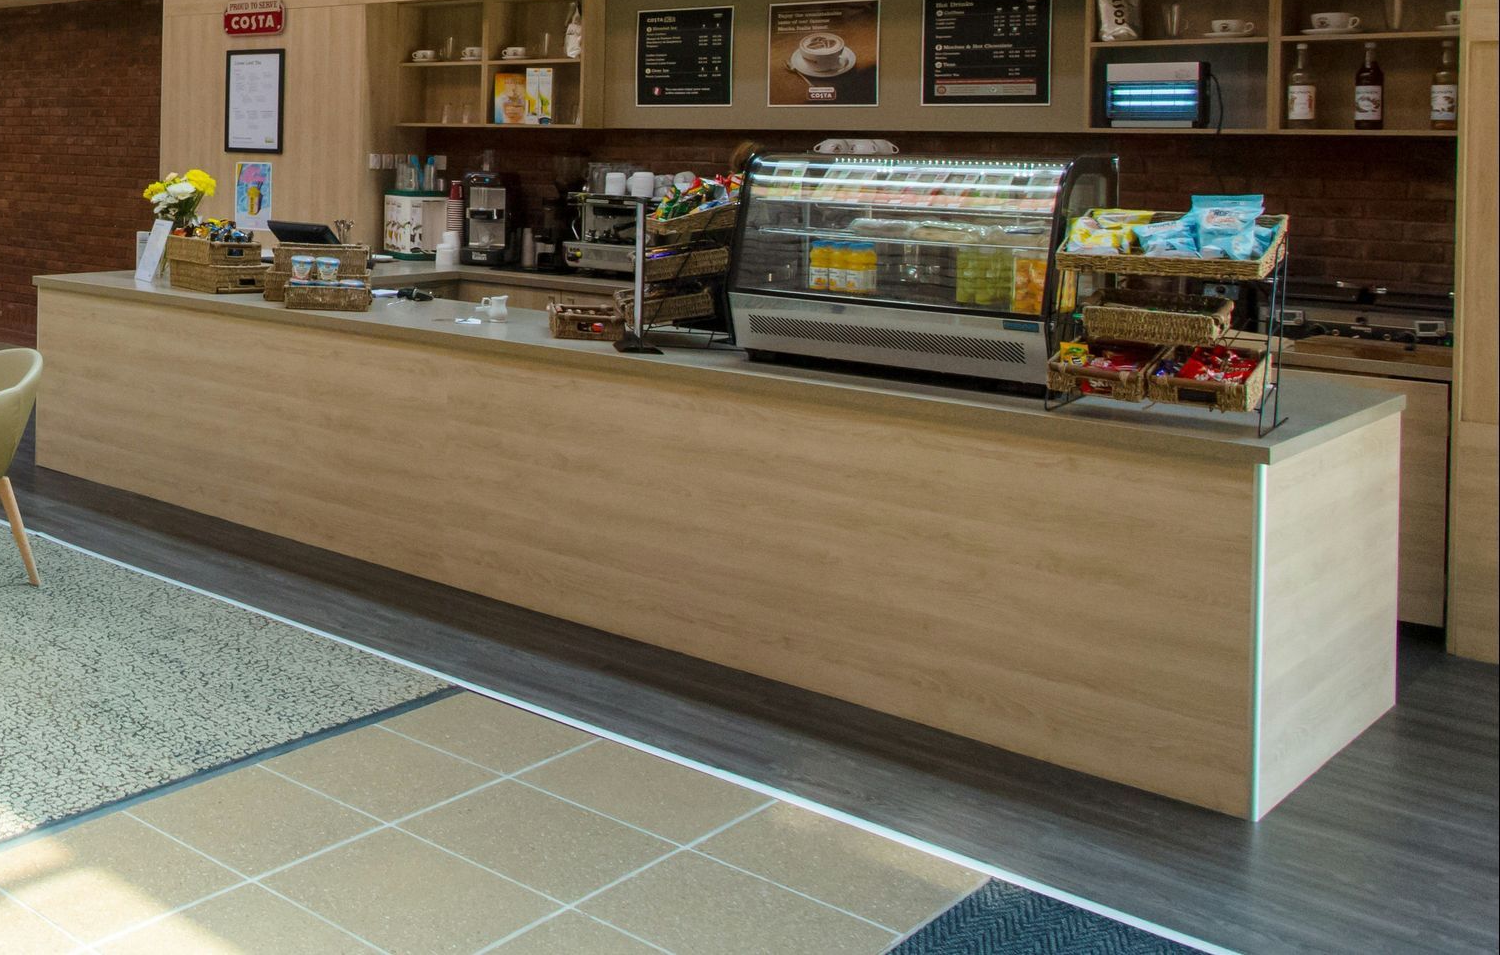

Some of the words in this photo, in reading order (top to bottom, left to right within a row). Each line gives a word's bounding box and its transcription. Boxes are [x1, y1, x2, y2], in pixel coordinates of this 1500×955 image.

[229, 2, 249, 11] PROUD
[250, 1, 258, 9] TO
[258, 0, 278, 9] SERVE
[231, 14, 275, 30] COSTA
